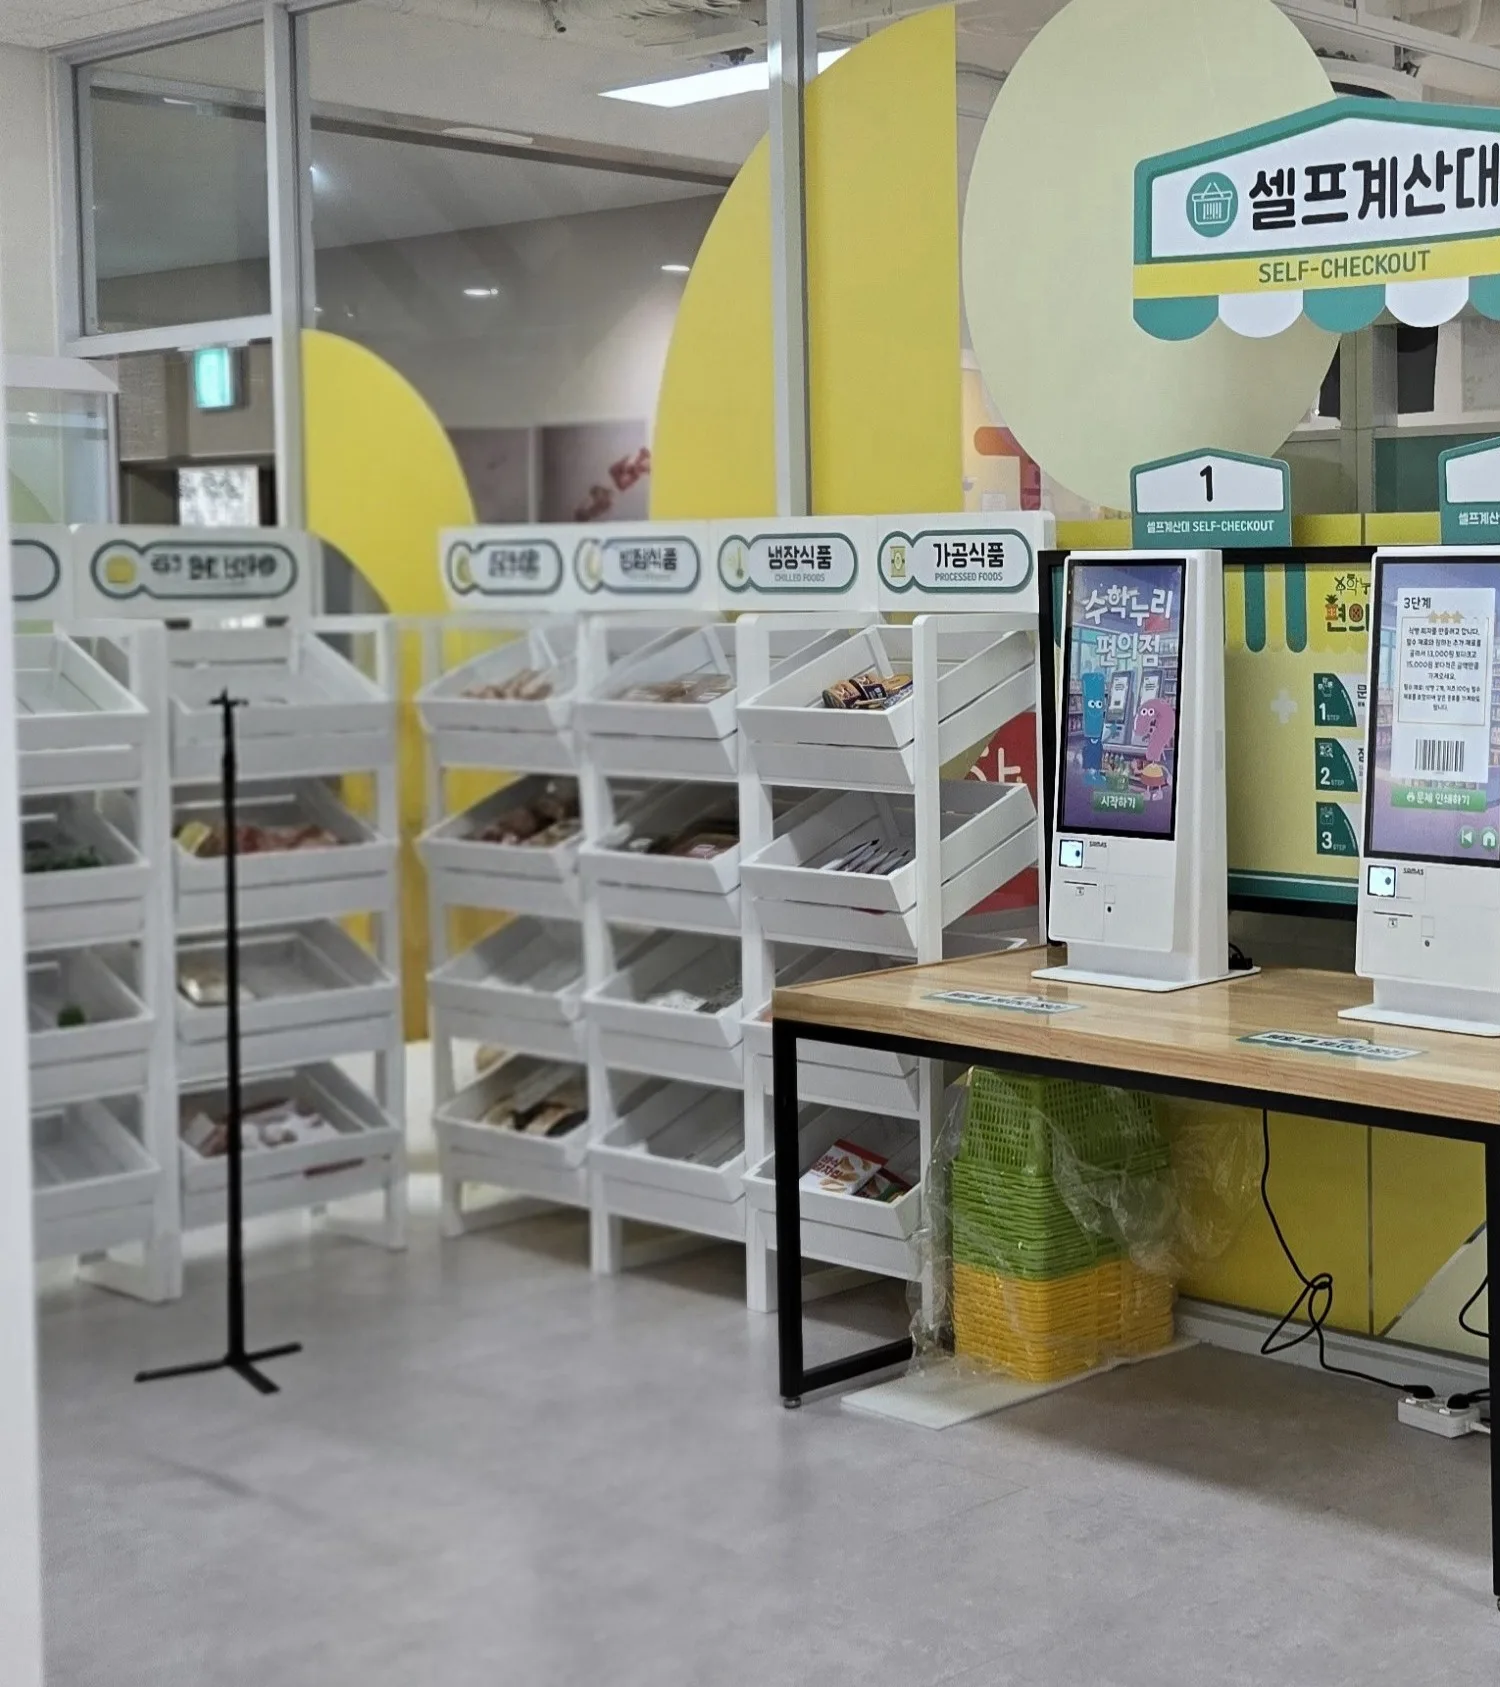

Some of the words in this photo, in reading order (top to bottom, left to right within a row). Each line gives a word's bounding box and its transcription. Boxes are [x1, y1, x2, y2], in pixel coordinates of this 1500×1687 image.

[1249, 142, 1500, 231] 셀프계산대
[1258, 250, 1431, 283] SELF-CHECKOUT
[1200, 465, 1213, 502] 1
[1147, 521, 1189, 533] 셀프계산대
[1192, 520, 1275, 532] SELF-CHECKOUT
[768, 545, 832, 570] 냉장식품
[933, 542, 1004, 569] 가공식품
[935, 573, 977, 581] PROCESSED
[979, 572, 1003, 581] FOODS
[1082, 584, 1173, 627] 수학누리
[1404, 597, 1431, 610] 3단계
[1096, 633, 1160, 667] 편의점
[1319, 703, 1327, 720] 1
[1320, 767, 1330, 785] 2
[1100, 794, 1137, 809] 시작하기
[1416, 791, 1433, 804] 문제
[1435, 792, 1470, 806] 인쇄하기
[1321, 831, 1333, 849] 3
